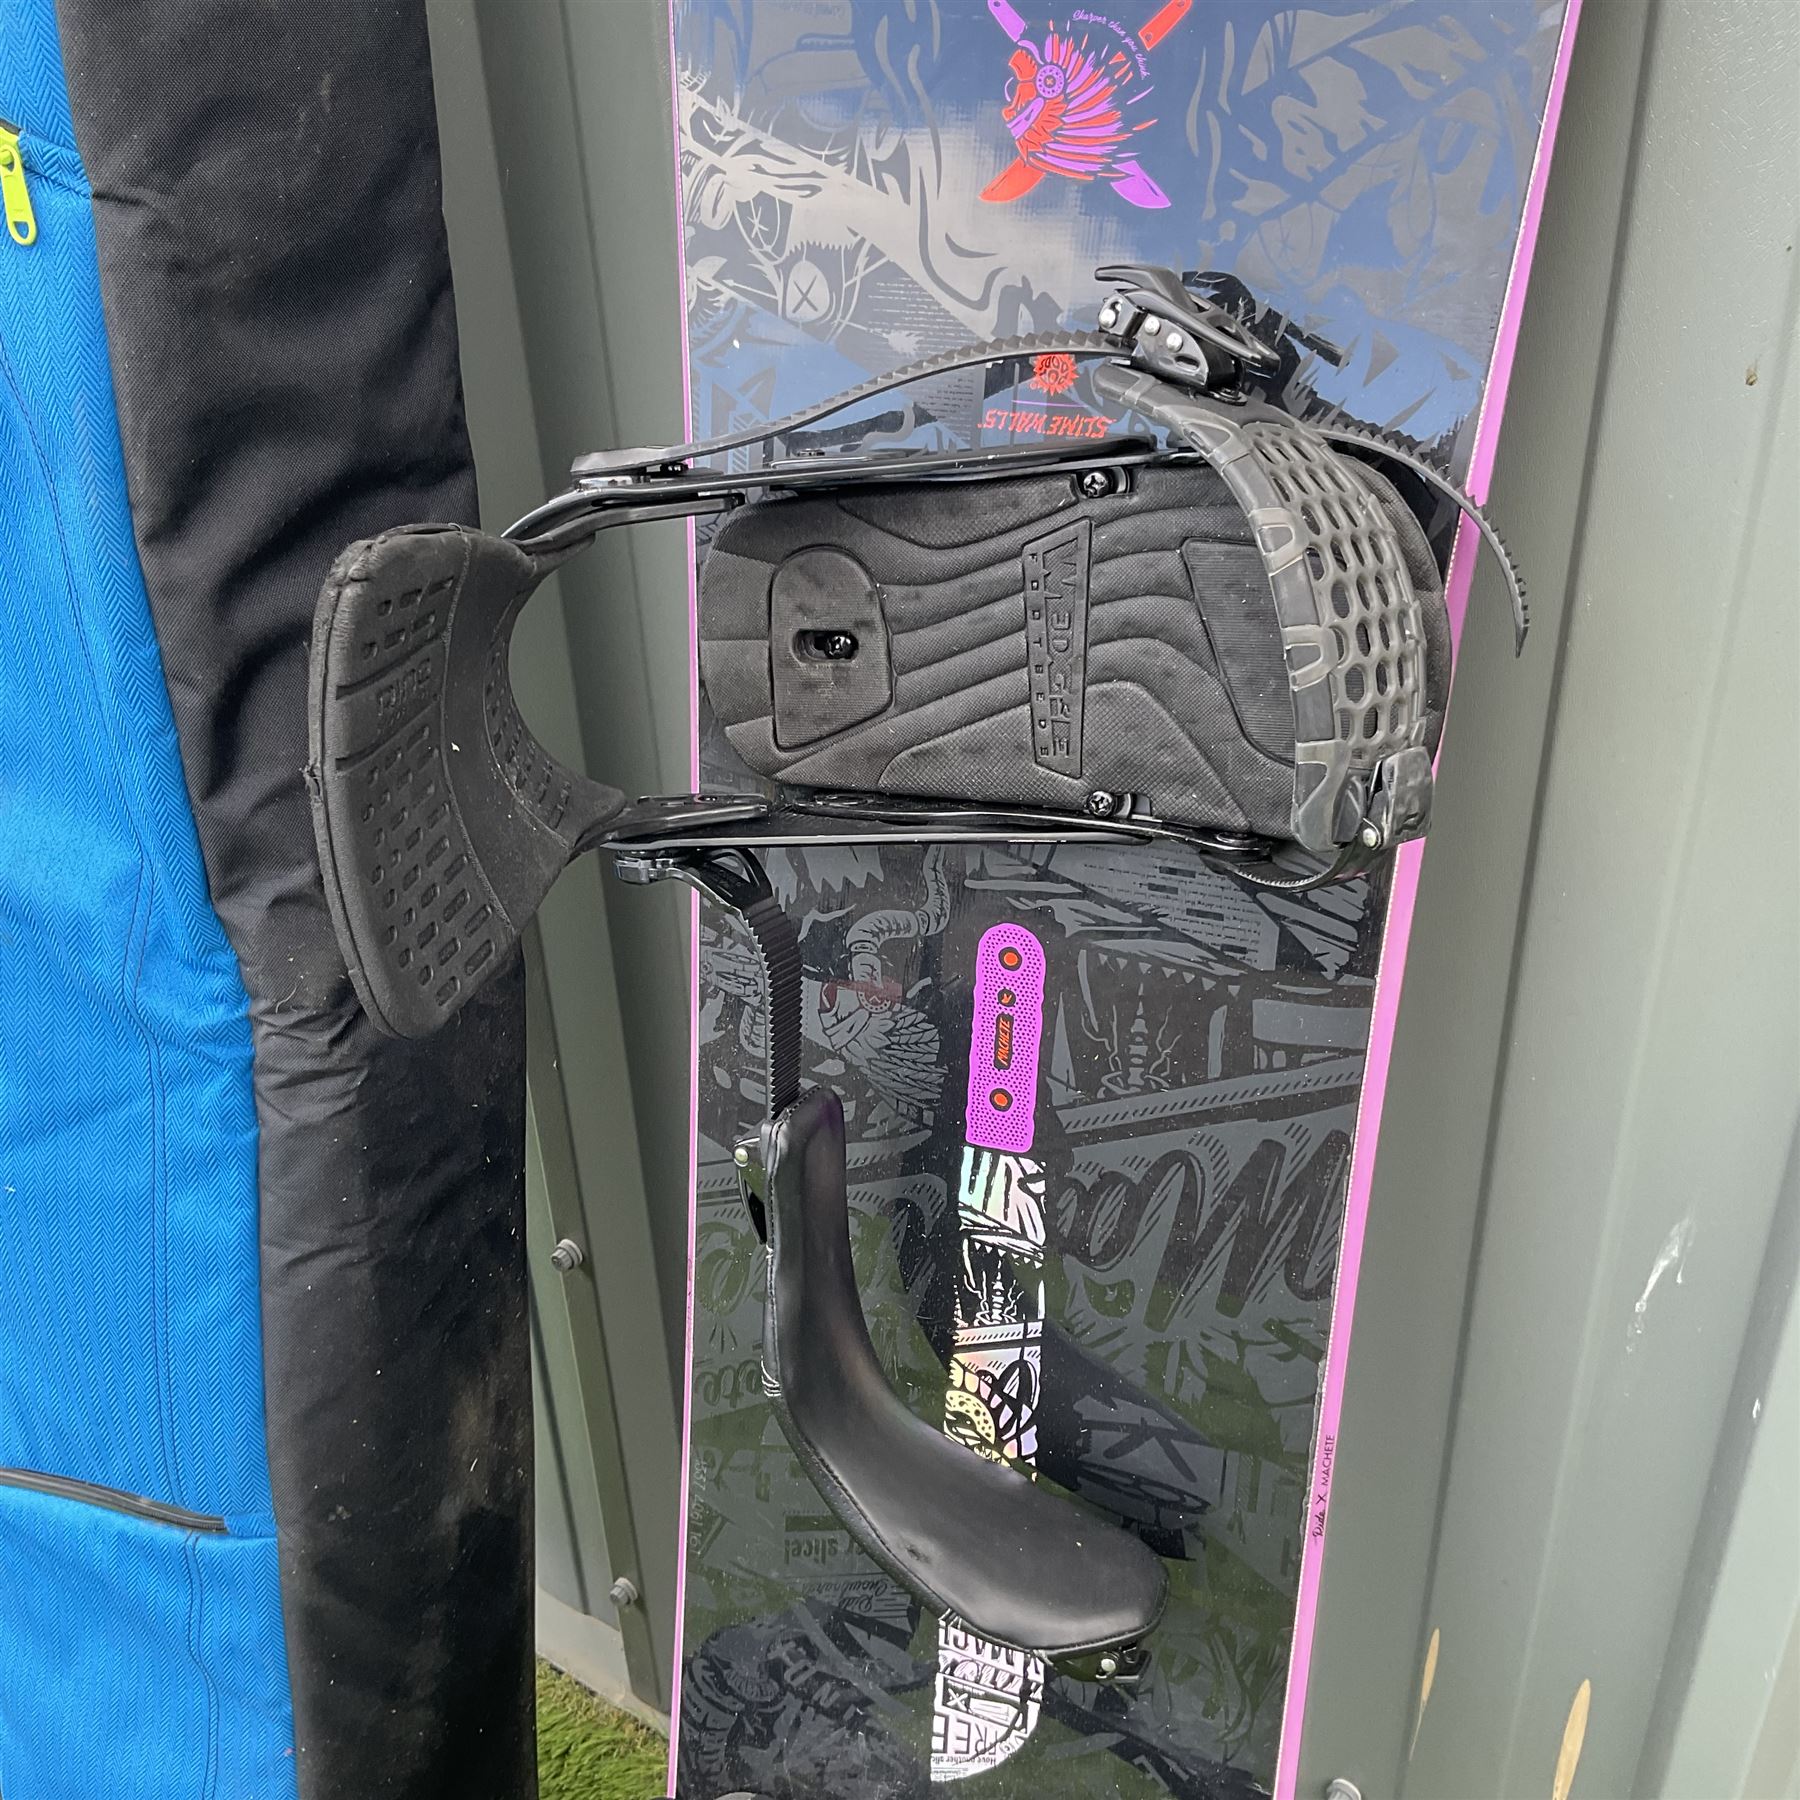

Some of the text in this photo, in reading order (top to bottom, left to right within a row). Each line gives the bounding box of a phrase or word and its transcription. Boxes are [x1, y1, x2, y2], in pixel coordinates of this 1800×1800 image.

[1046, 414, 1118, 439] SLIME
[996, 1017, 1011, 1066] MACHETE
[1320, 1434, 1335, 1487] MACHETE
[784, 1537, 839, 1565] slice!
